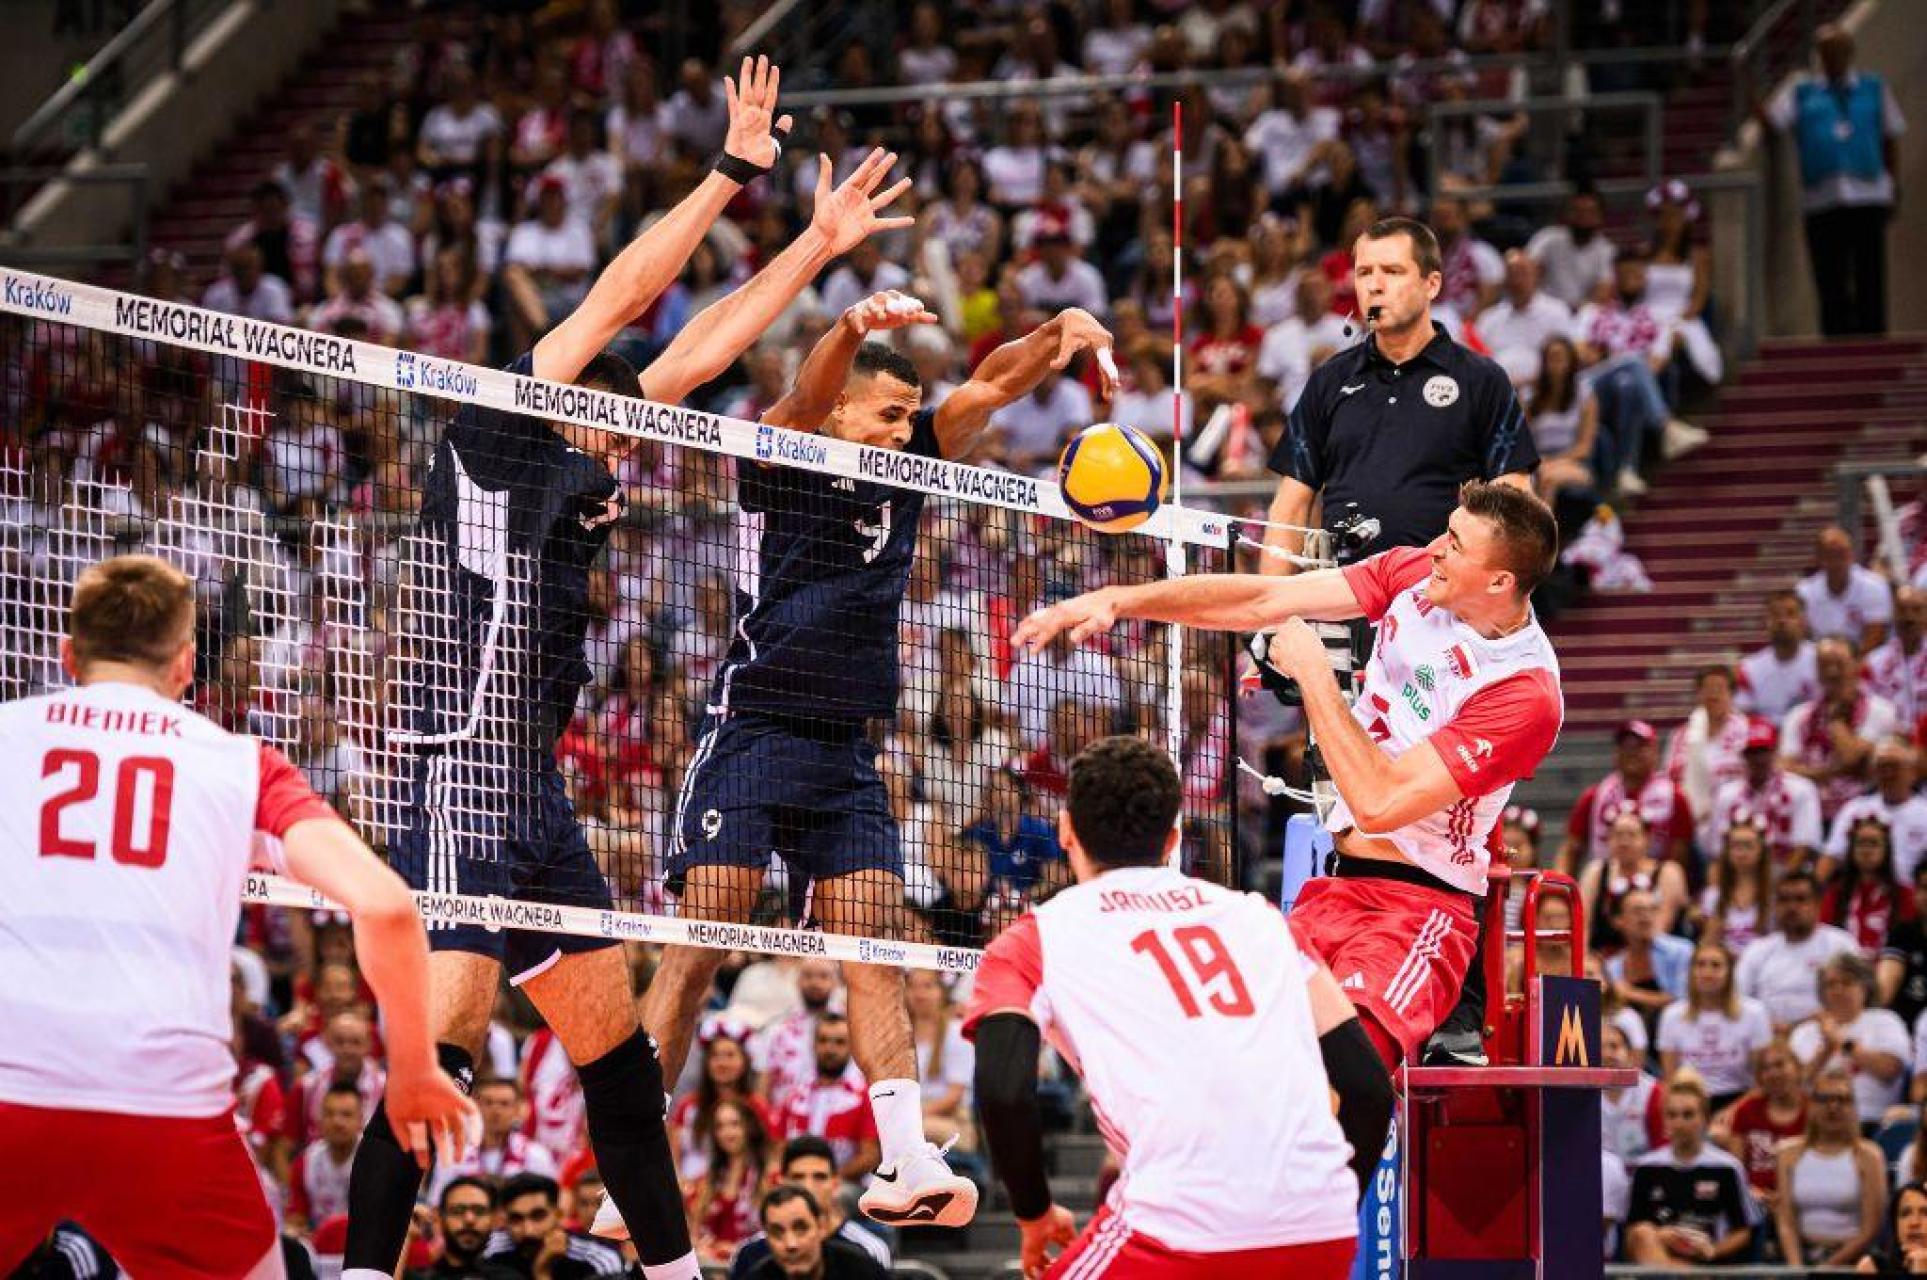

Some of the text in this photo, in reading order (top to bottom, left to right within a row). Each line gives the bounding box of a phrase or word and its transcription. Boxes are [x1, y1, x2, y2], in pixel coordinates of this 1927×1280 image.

[5, 276, 72, 315] Kraków
[116, 297, 356, 373] MEMORIAŁ WAGNERA
[421, 362, 477, 396] Kraków
[514, 378, 722, 447] MEMORIAŁ WAGNERA
[776, 432, 827, 465] Kraków
[859, 447, 1039, 508] MEMORIAŁ WAGNERA
[46, 703, 182, 737] BIENIEK
[1402, 681, 1431, 720] plus
[40, 747, 174, 868] 20
[701, 808, 722, 841] 9
[490, 902, 563, 928] WAGNERA
[1100, 885, 1211, 912] JANUSZ
[688, 924, 827, 955] MEMORIAŁ WAGNERA
[1130, 925, 1255, 1019] 19
[1376, 1168, 1396, 1280] Sen
